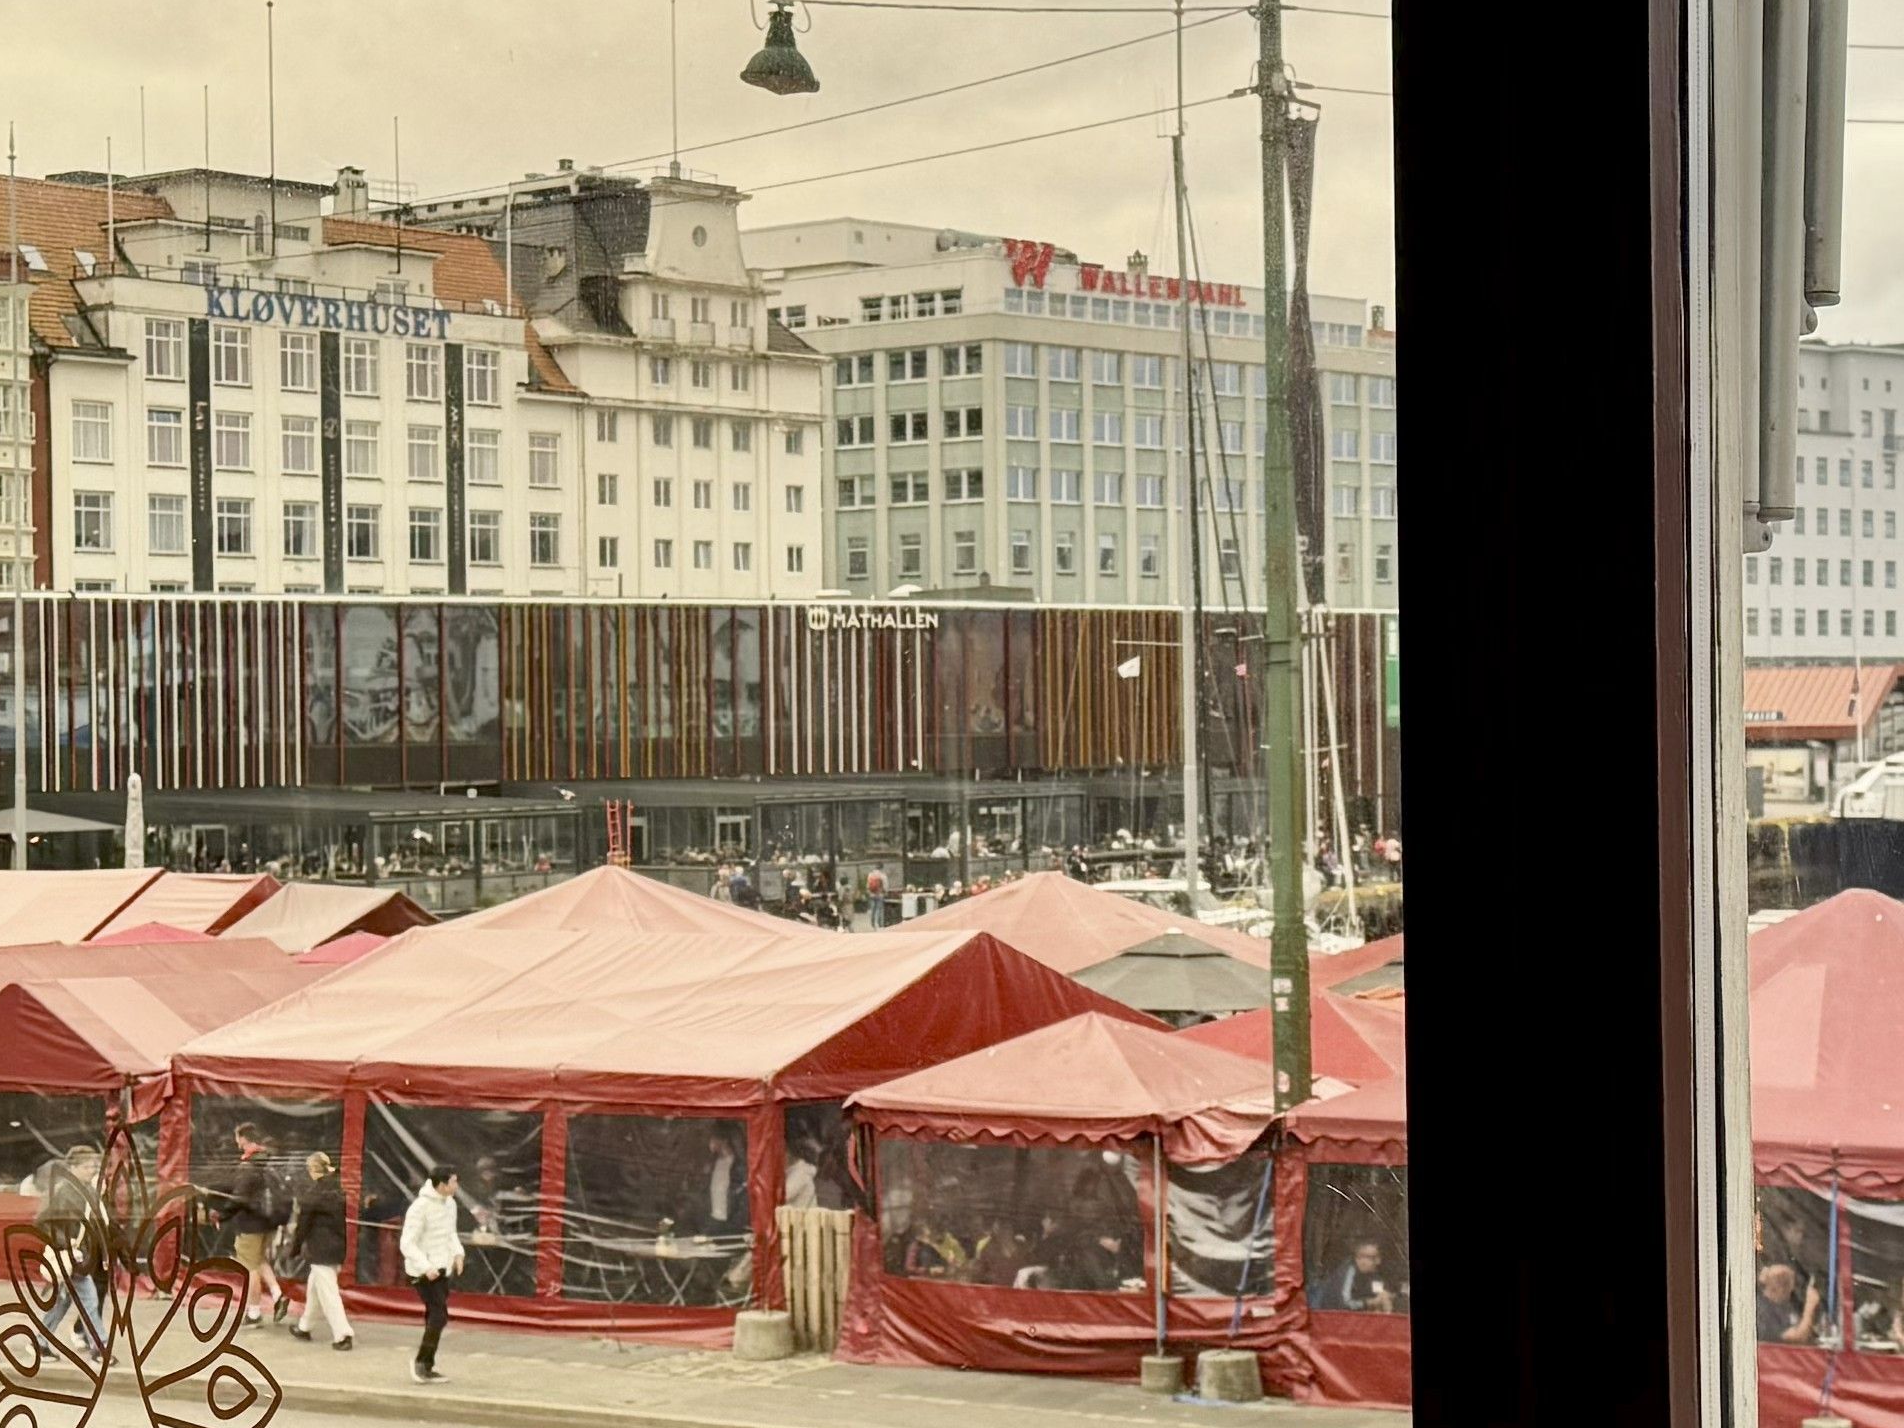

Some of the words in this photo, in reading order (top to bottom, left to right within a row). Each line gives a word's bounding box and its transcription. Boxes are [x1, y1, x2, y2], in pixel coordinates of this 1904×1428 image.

[1081, 265, 1247, 307] WALLENDAHL
[206, 286, 452, 340] KLØVERHUSET
[833, 612, 939, 629] MATHALLEN
